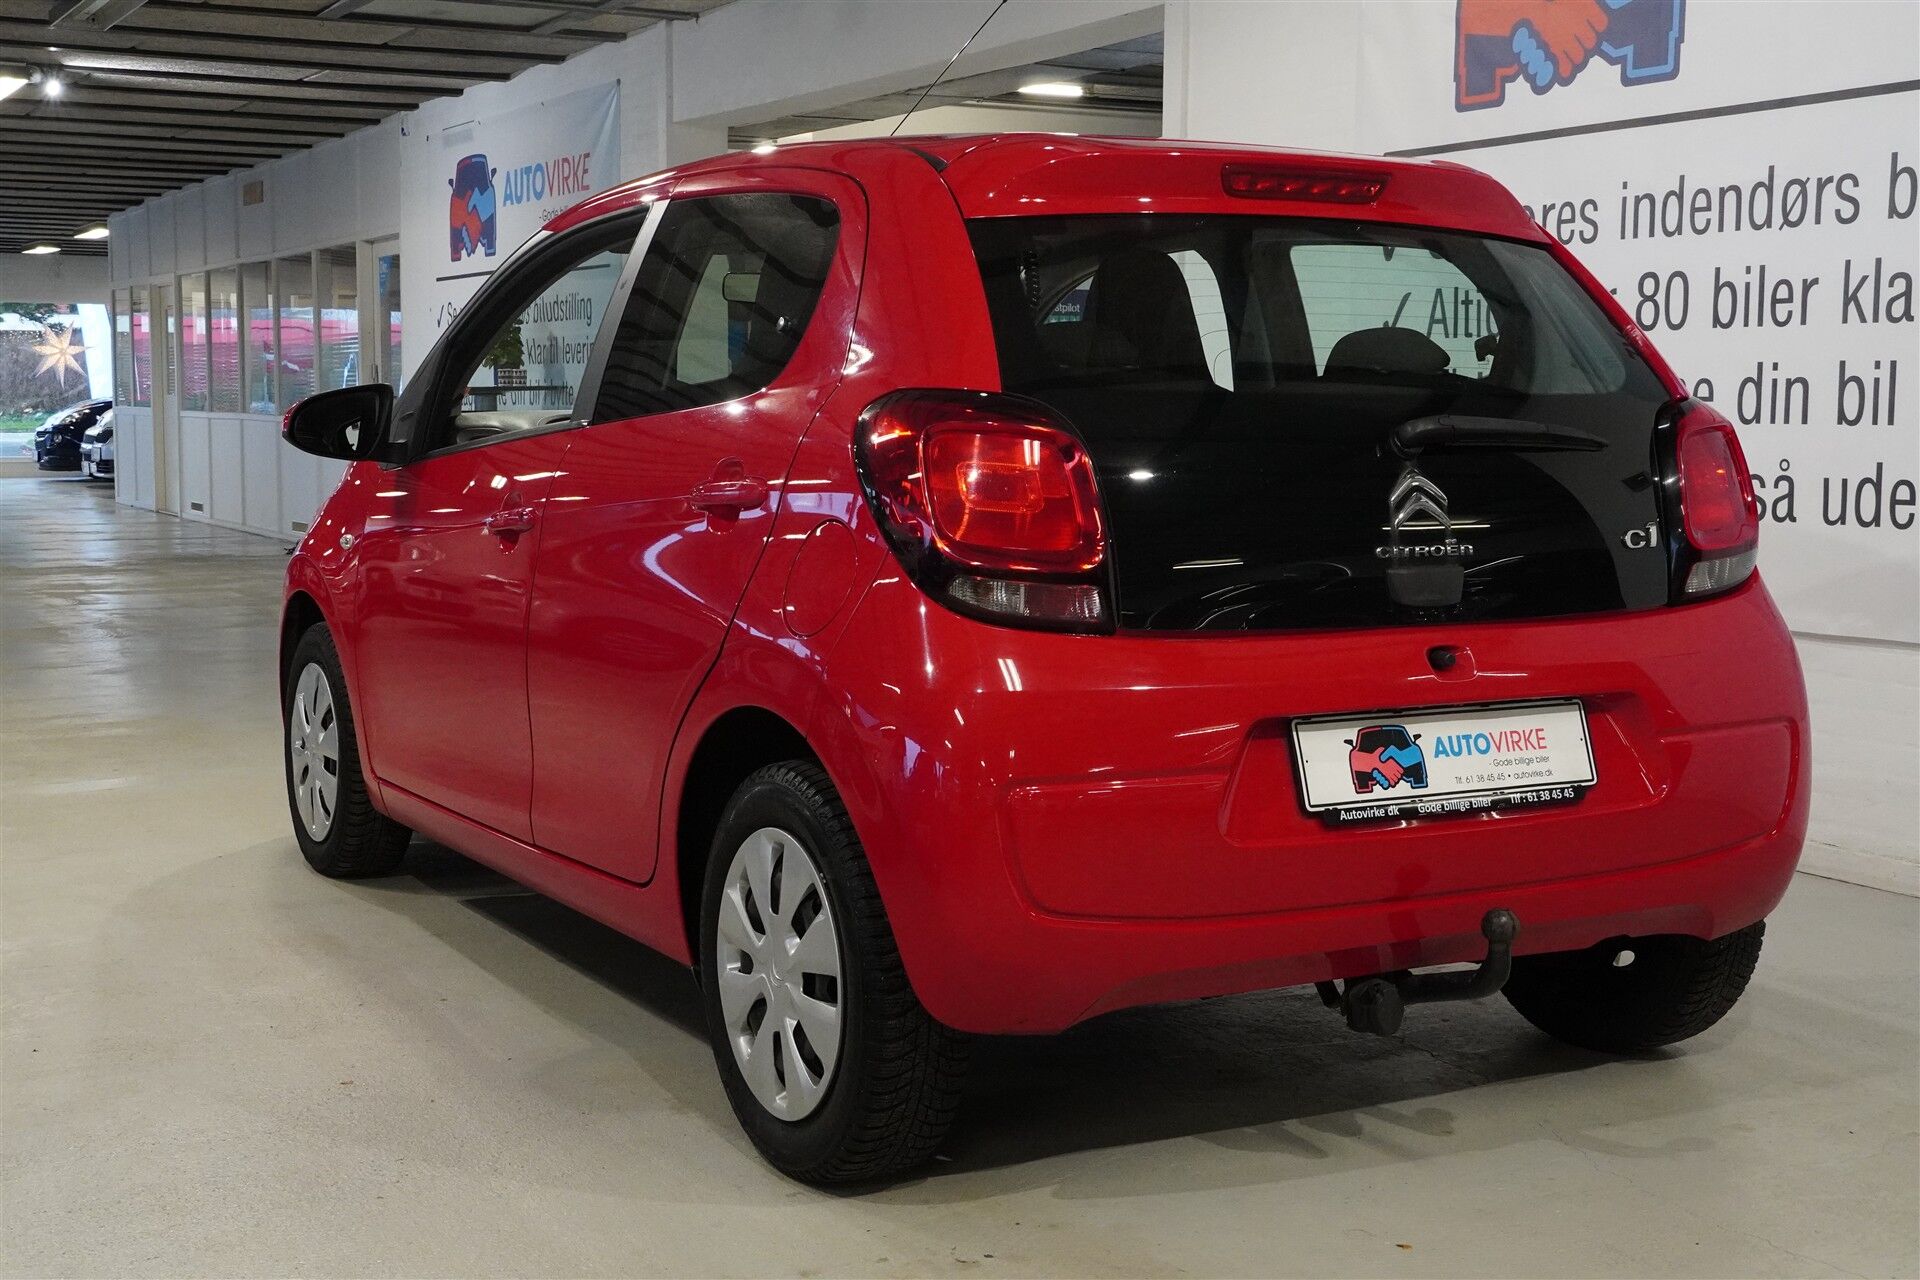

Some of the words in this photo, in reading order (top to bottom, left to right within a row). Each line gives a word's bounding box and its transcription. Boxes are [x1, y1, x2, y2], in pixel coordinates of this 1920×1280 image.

[503, 152, 590, 207] AUTOVIRKE
[1620, 164, 1861, 240] indendørs
[533, 293, 592, 327] biludstilling
[1636, 269, 1690, 332] 80
[1712, 264, 1820, 330] biler
[526, 338, 546, 365] klar
[549, 337, 559, 365] til
[1737, 361, 1810, 425] din
[1837, 360, 1897, 426] bil
[1434, 728, 1548, 759] AUTOVIRKE
[1465, 775, 1474, 783] 61
[1476, 774, 1485, 783] 38
[1486, 773, 1495, 782] 45
[1496, 772, 1505, 781] 45
[1513, 769, 1553, 780] autovirke.dk
[1493, 758, 1513, 767] Gode
[1514, 756, 1534, 767] billige
[1535, 755, 1550, 764] biler
[1340, 806, 1385, 821] Autovirke
[1387, 805, 1399, 816] dk
[1417, 802, 1442, 813] Gode
[1444, 799, 1470, 812] billige
[1472, 798, 1492, 809] biler
[1527, 792, 1538, 802] 61
[1539, 791, 1551, 801] 38
[1551, 789, 1562, 799] 45
[1563, 788, 1574, 798] 45
